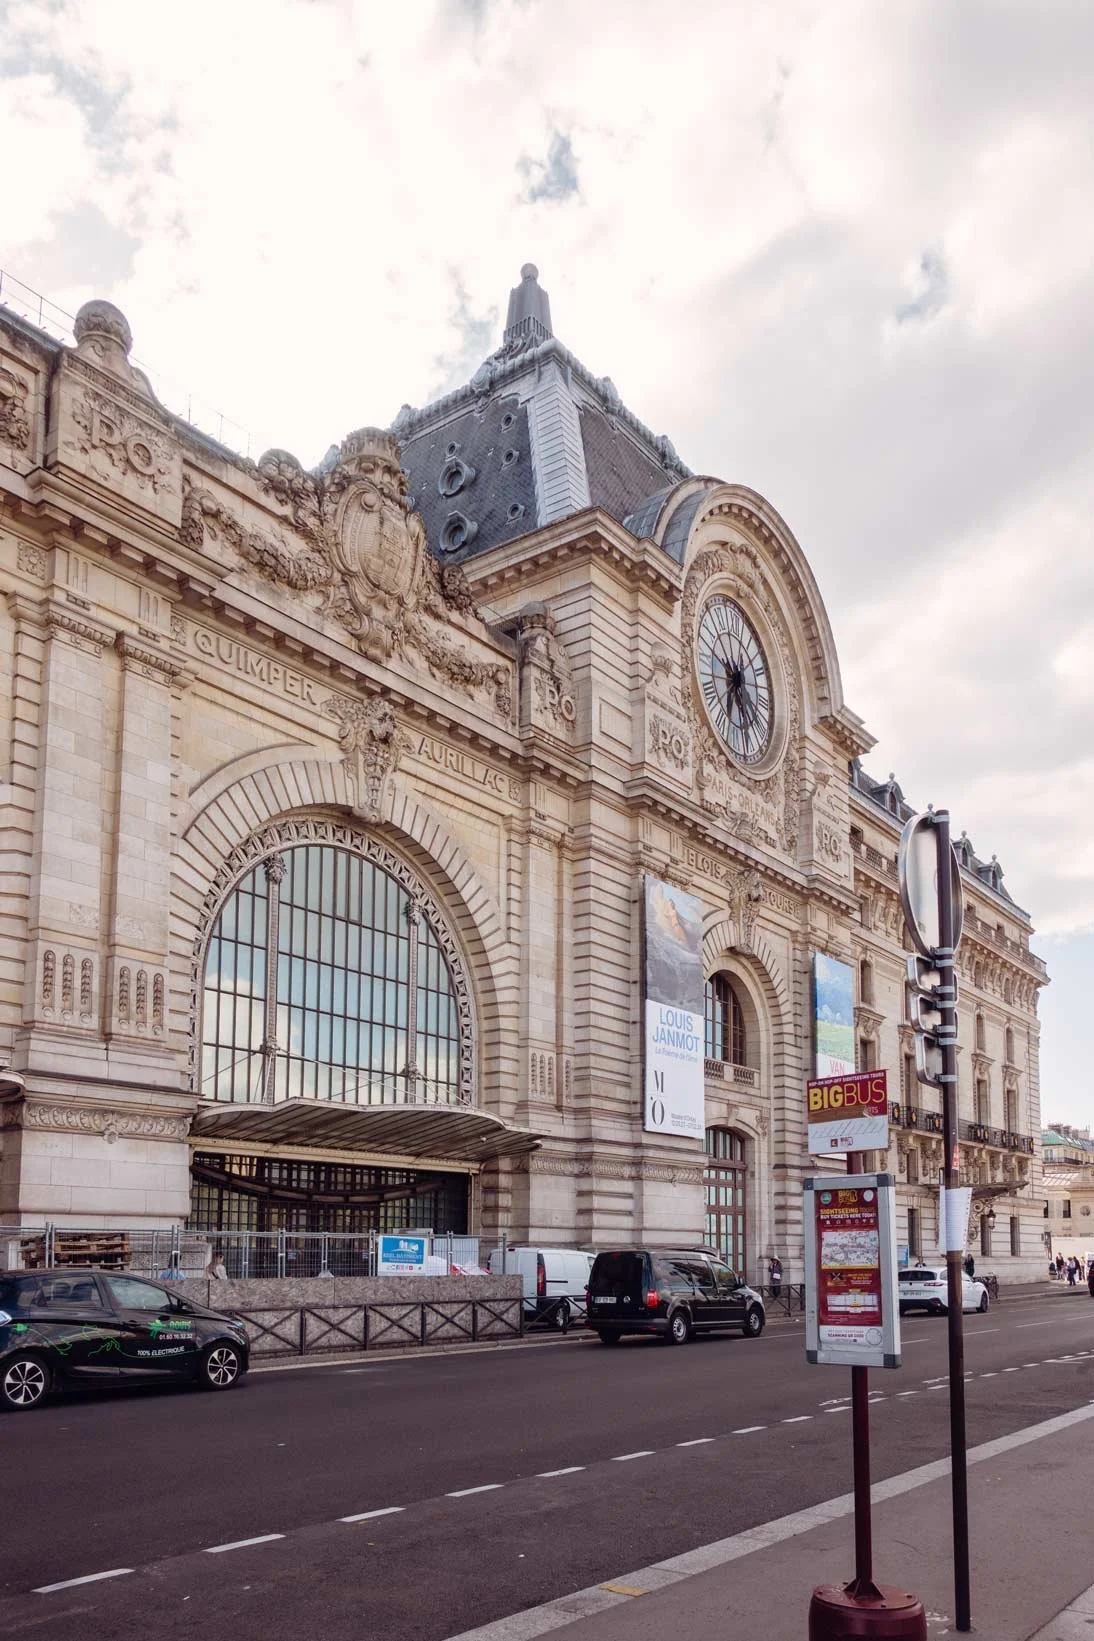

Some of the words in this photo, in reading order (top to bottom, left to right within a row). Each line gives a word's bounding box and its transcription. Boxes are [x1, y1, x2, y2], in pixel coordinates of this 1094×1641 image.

[729, 609, 740, 638] XII
[193, 629, 317, 706] QUIMPER
[417, 737, 505, 794] AURILLAC
[687, 848, 722, 880] BLOIS
[660, 1008, 693, 1032] LOUIS
[652, 1026, 700, 1052] JANMOT
[829, 1058, 845, 1077] VAN
[843, 1073, 869, 1081] SIGHTSEEING
[820, 1207, 859, 1215] SIGHTSEEING
